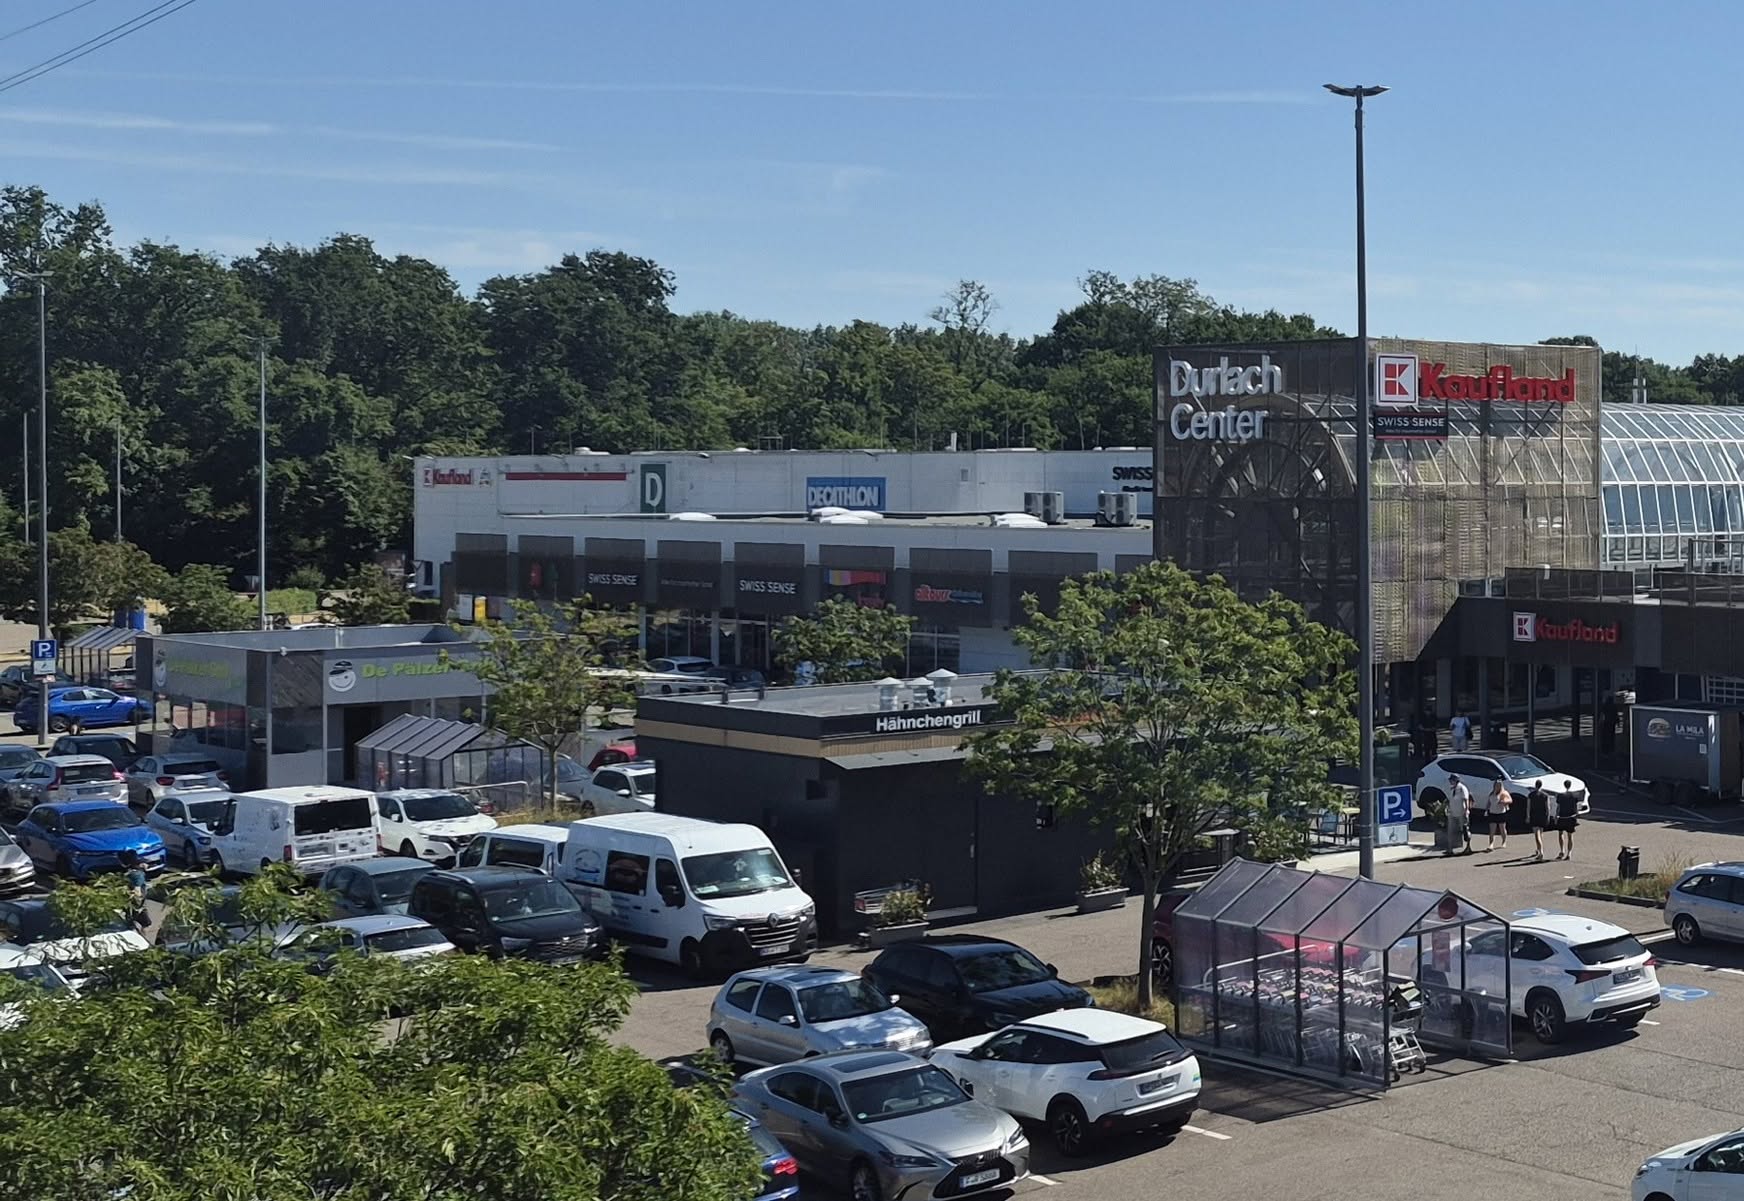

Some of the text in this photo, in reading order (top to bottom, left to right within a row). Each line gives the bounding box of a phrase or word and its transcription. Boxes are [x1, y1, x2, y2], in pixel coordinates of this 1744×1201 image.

[1170, 354, 1282, 397] Durlach
[1419, 361, 1576, 402] Kaufland
[1170, 402, 1269, 440] Center
[1377, 417, 1445, 428] SWISS SENSE
[432, 468, 473, 485] Kaufland
[1112, 466, 1153, 480] SWISS
[645, 472, 663, 508] D
[807, 485, 879, 507] DECATHLON
[588, 572, 639, 586] SWISS SENSE
[739, 579, 797, 594] SWISS SENSE
[1535, 616, 1620, 644] Kaufland
[39, 642, 51, 657] P
[362, 663, 388, 678] De
[875, 709, 982, 732] Hähnchengrill
[1383, 791, 1402, 820] P
